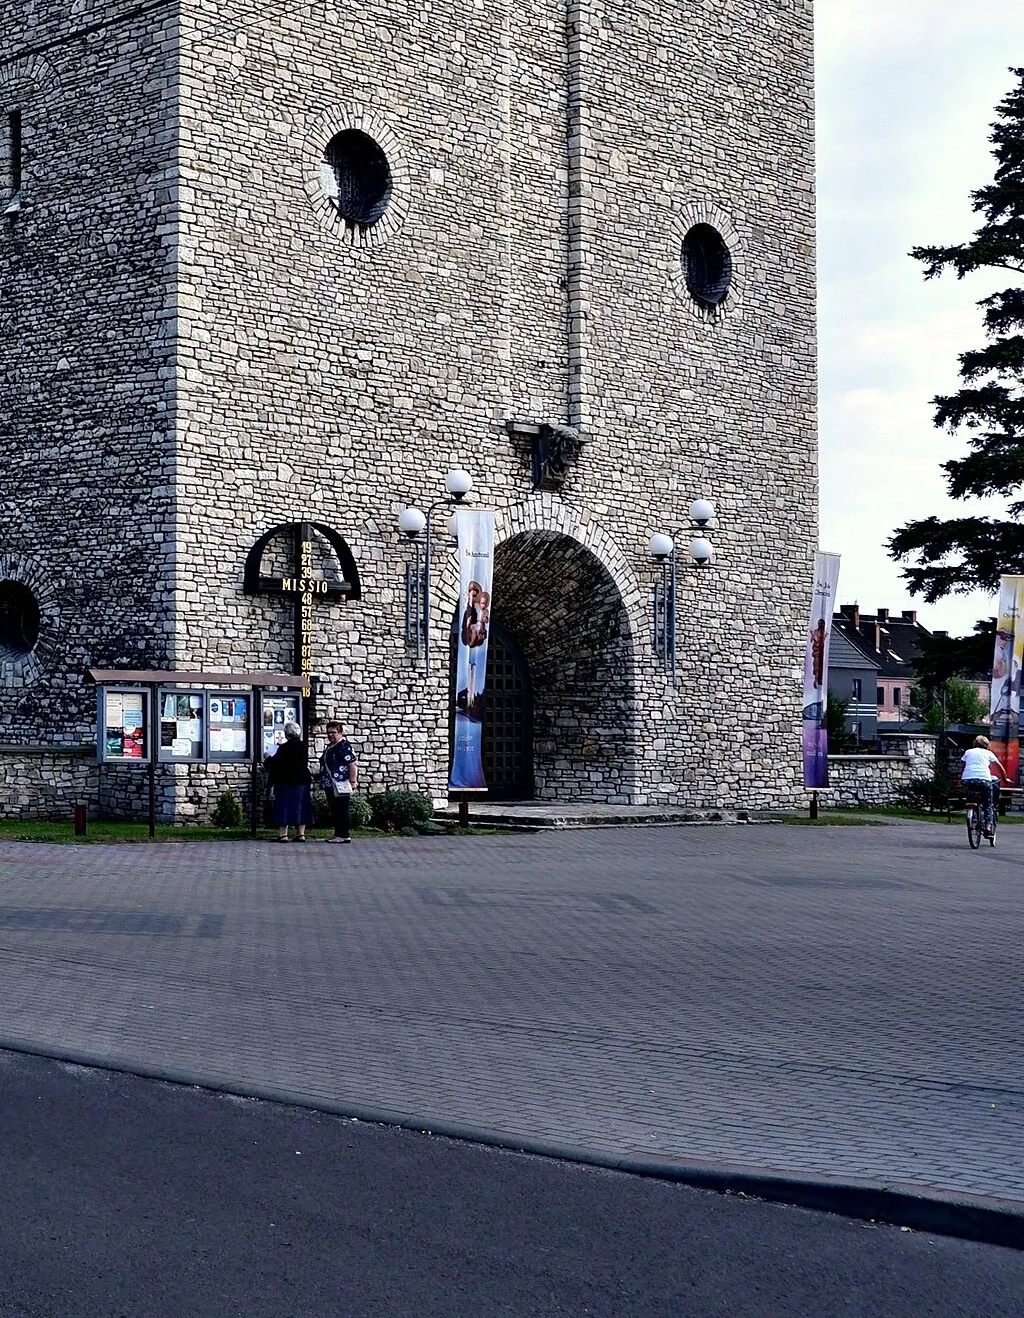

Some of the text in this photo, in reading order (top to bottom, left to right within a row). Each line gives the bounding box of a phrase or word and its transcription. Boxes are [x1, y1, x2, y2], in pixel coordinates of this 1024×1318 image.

[301, 541, 312, 554] 19
[301, 553, 312, 567] 27
[301, 566, 312, 579] 39
[282, 578, 328, 594] MISSIO
[301, 592, 313, 605] 48
[301, 605, 312, 618] 57
[301, 618, 312, 631] 68
[301, 631, 312, 644] 77
[301, 644, 312, 657] 87
